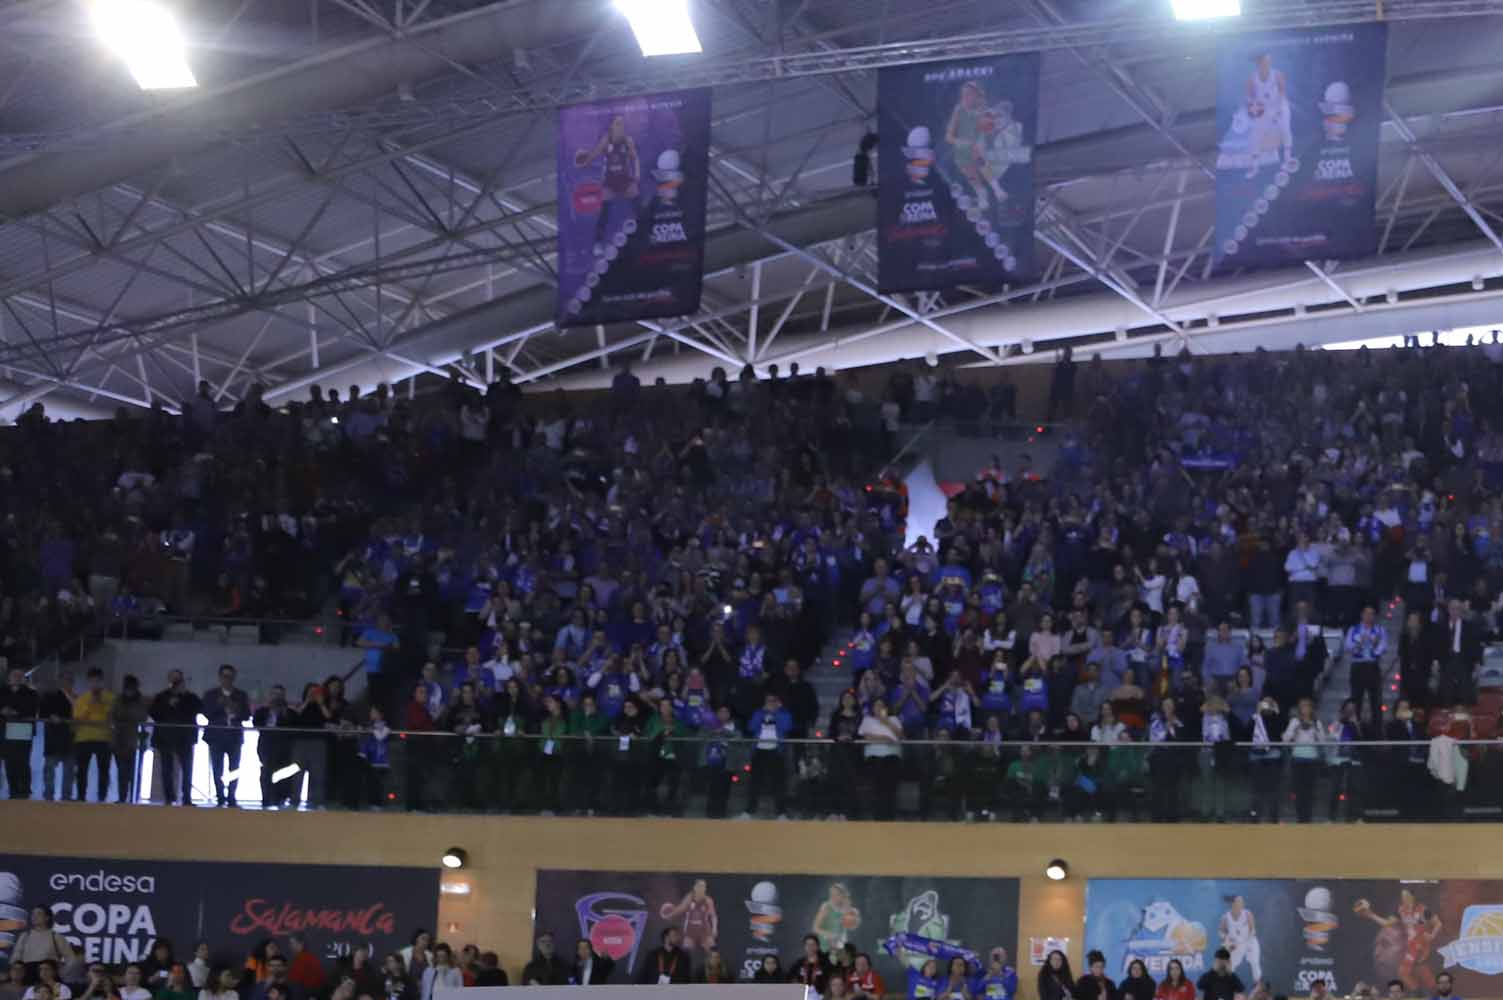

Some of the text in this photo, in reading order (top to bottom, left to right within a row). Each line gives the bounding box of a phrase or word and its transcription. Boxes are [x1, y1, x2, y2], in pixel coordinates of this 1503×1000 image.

[50, 870, 155, 893] endesa
[50, 902, 157, 934] COPA
[1298, 970, 1334, 982] COPA
